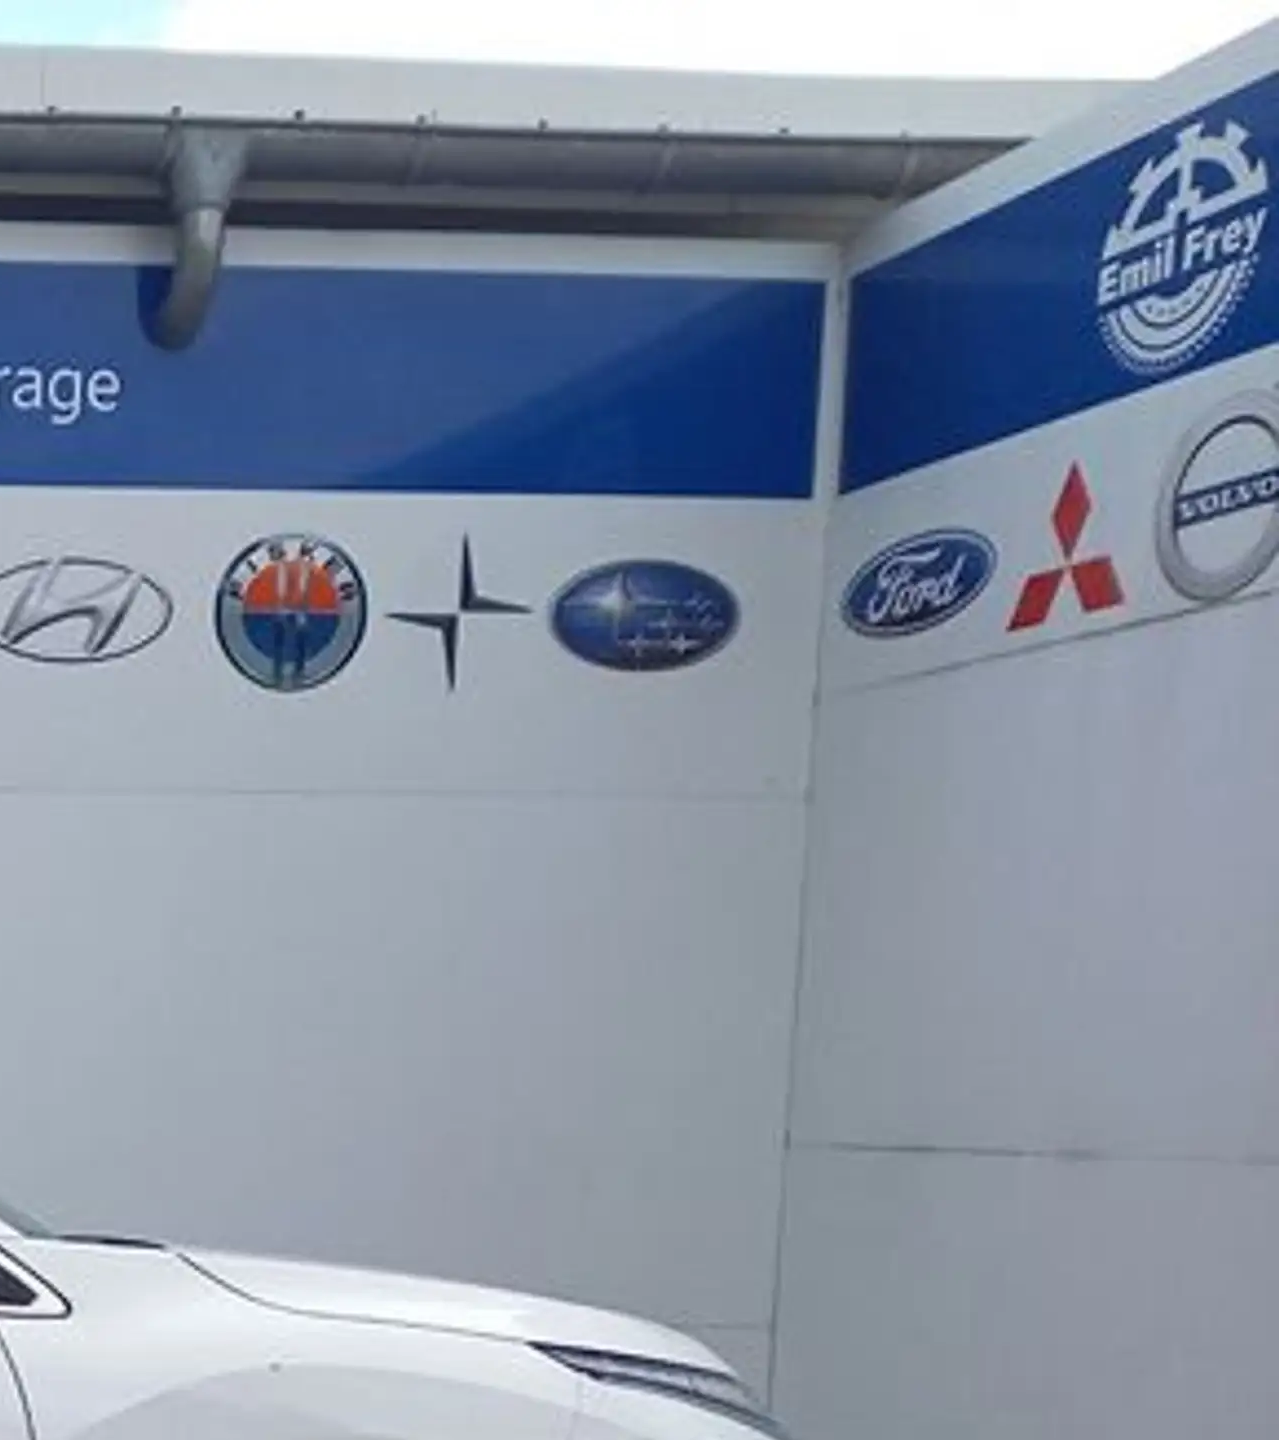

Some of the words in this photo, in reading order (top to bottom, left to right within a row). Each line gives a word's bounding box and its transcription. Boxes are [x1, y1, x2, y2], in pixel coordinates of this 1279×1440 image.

[1098, 236, 1175, 304] Emil
[1182, 207, 1268, 271] Frey
[1178, 475, 1279, 519] VOLVO
[867, 546, 967, 624] Ford
